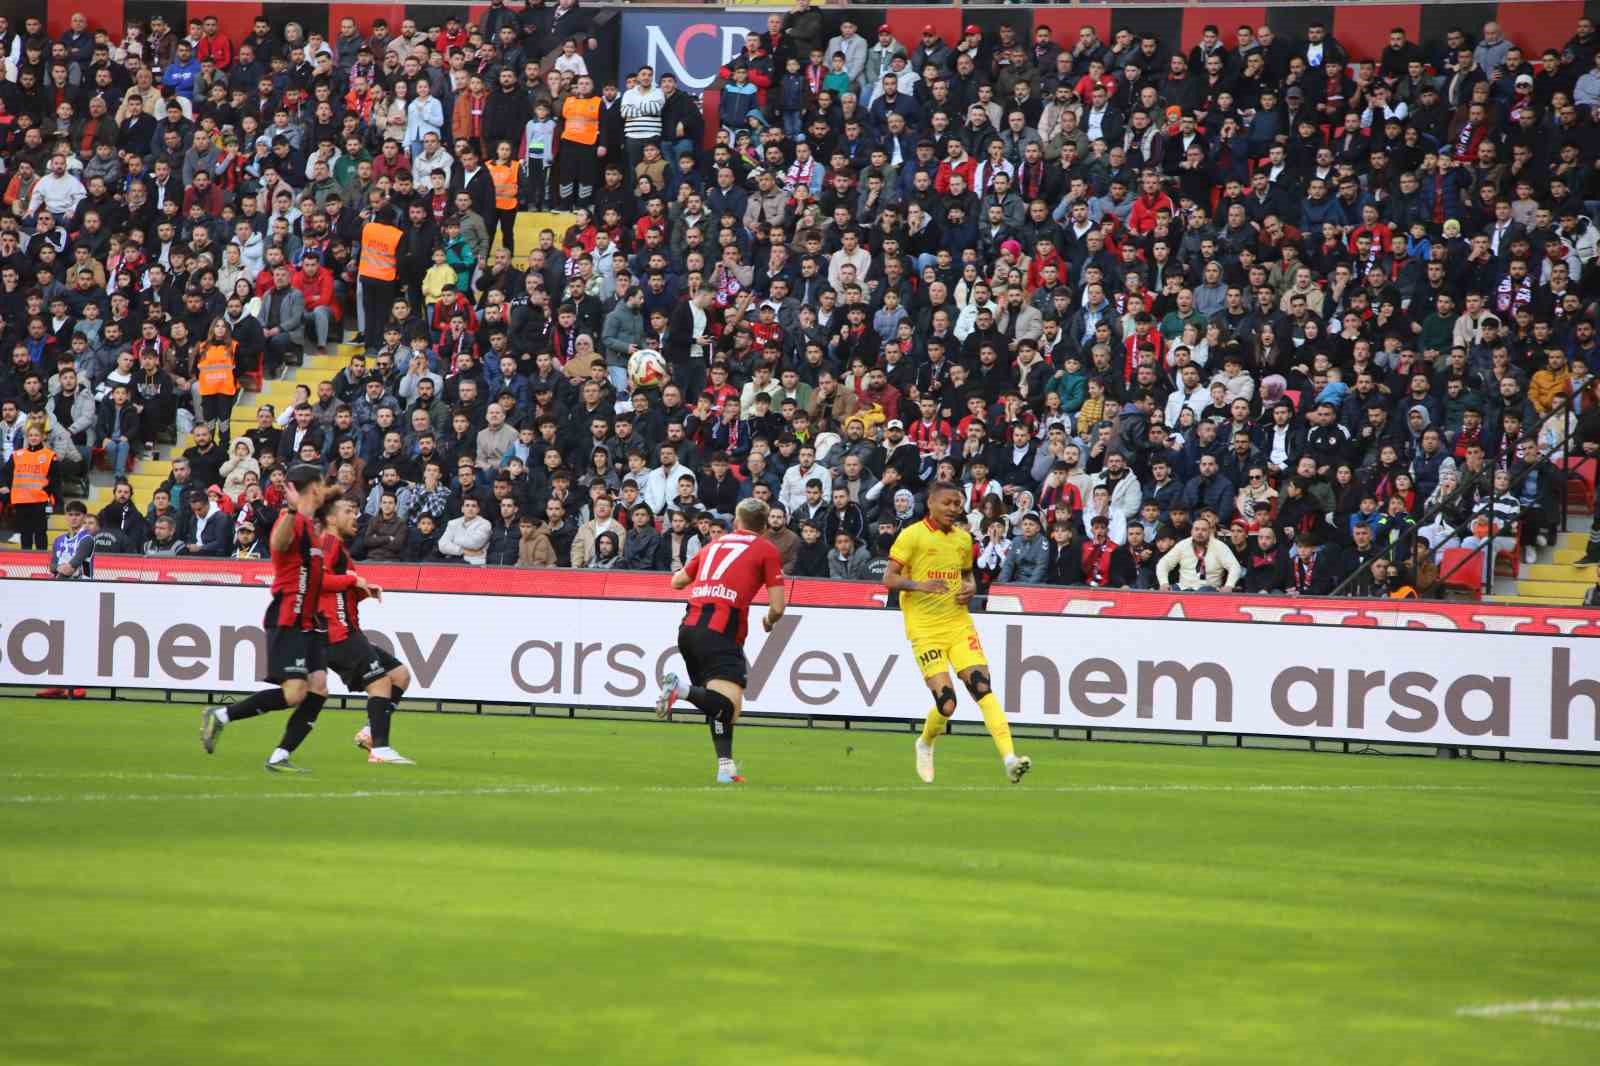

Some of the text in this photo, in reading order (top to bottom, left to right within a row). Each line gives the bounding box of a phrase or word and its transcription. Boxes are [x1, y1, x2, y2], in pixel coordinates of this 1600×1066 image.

[700, 543, 750, 582] 17
[0, 617, 65, 676] a
[919, 648, 943, 667] HDI
[1005, 625, 1233, 722] hem
[1270, 665, 1510, 739] arsa
